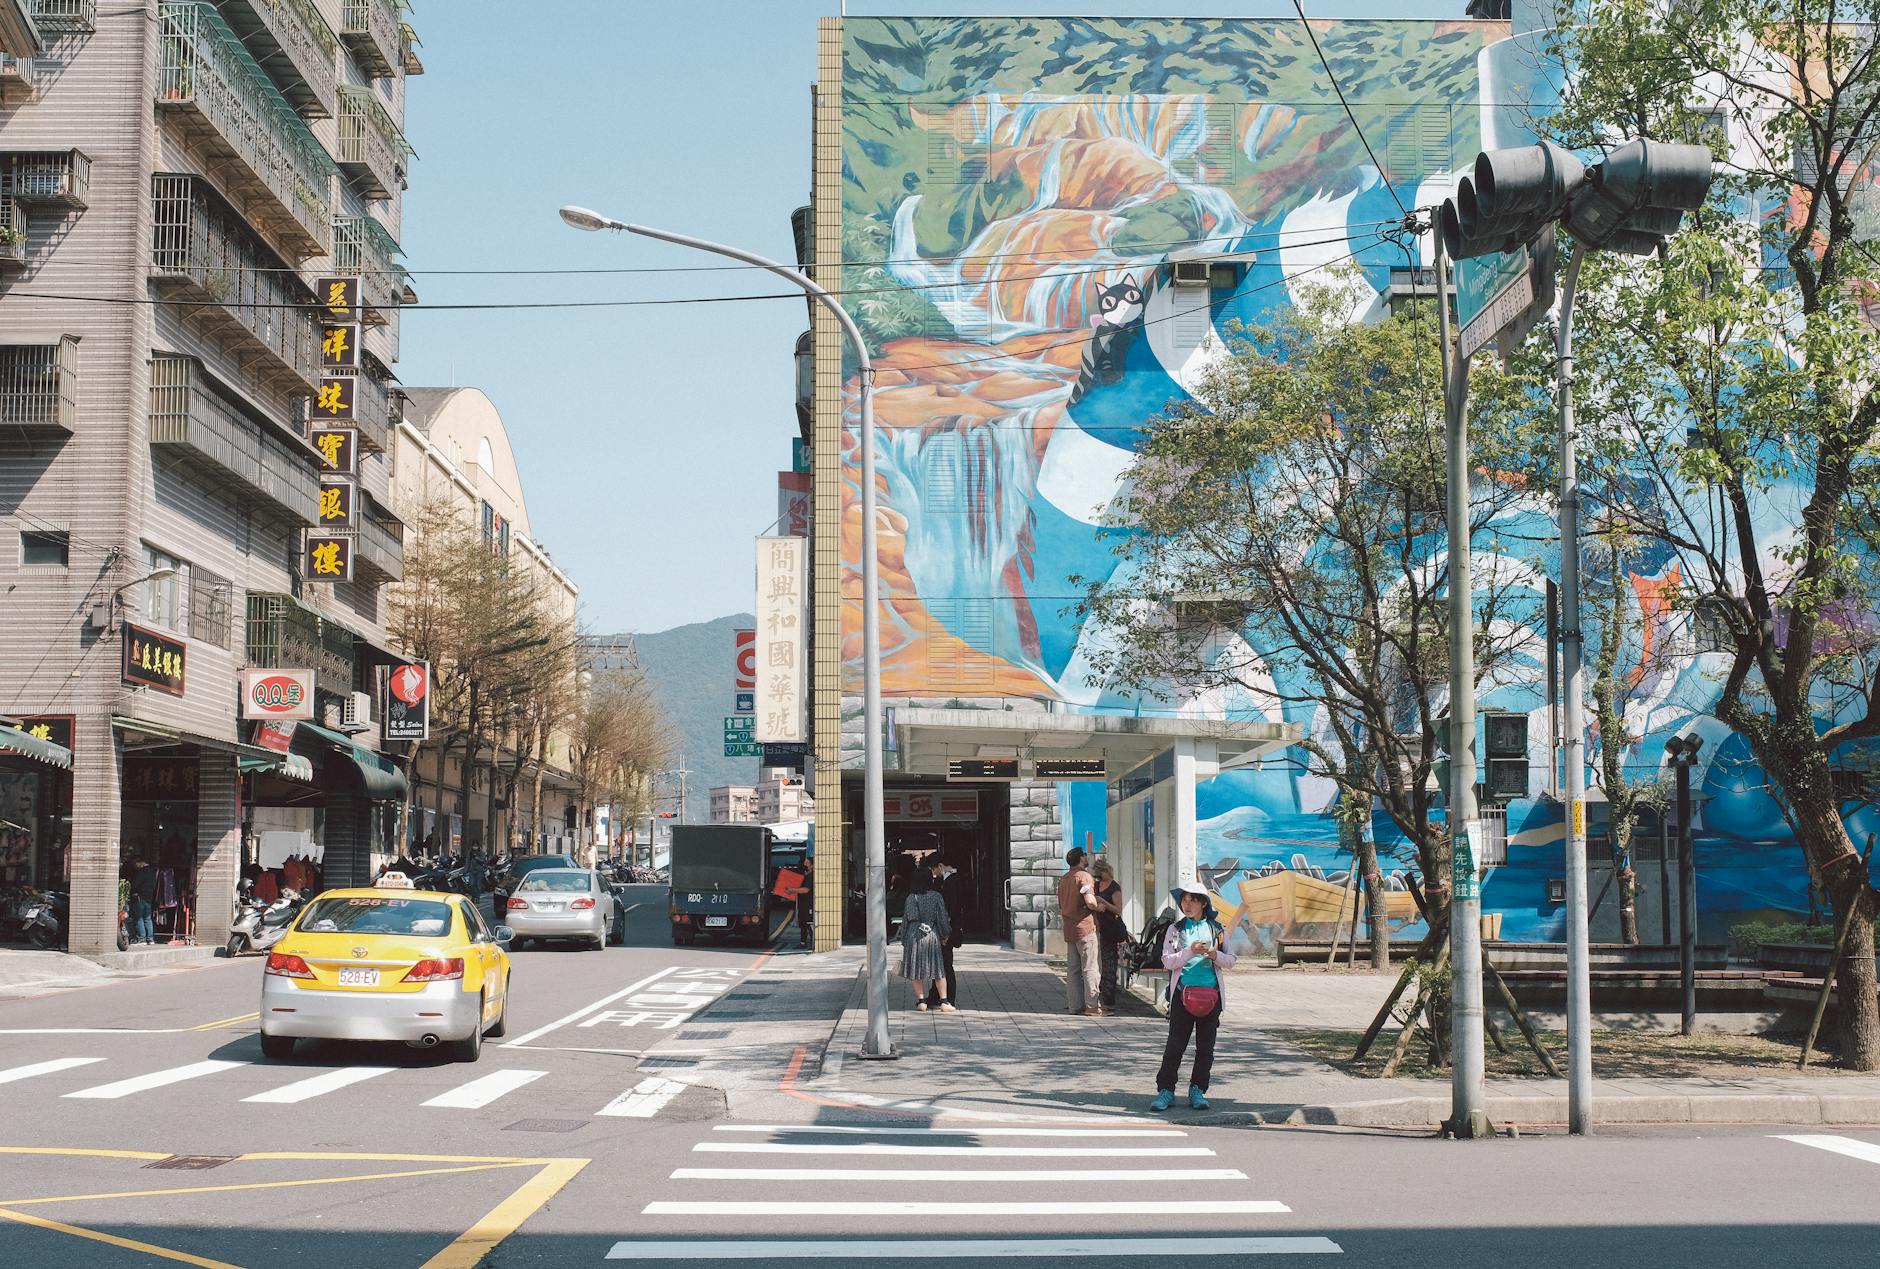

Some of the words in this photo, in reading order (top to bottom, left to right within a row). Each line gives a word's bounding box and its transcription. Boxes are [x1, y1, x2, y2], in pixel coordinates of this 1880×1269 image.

[312, 281, 349, 575] 益祥珠寶銀樓
[766, 542, 798, 737] 簡興和國藥號
[255, 684, 301, 706] QQ堡
[340, 972, 378, 985] 528-EV
